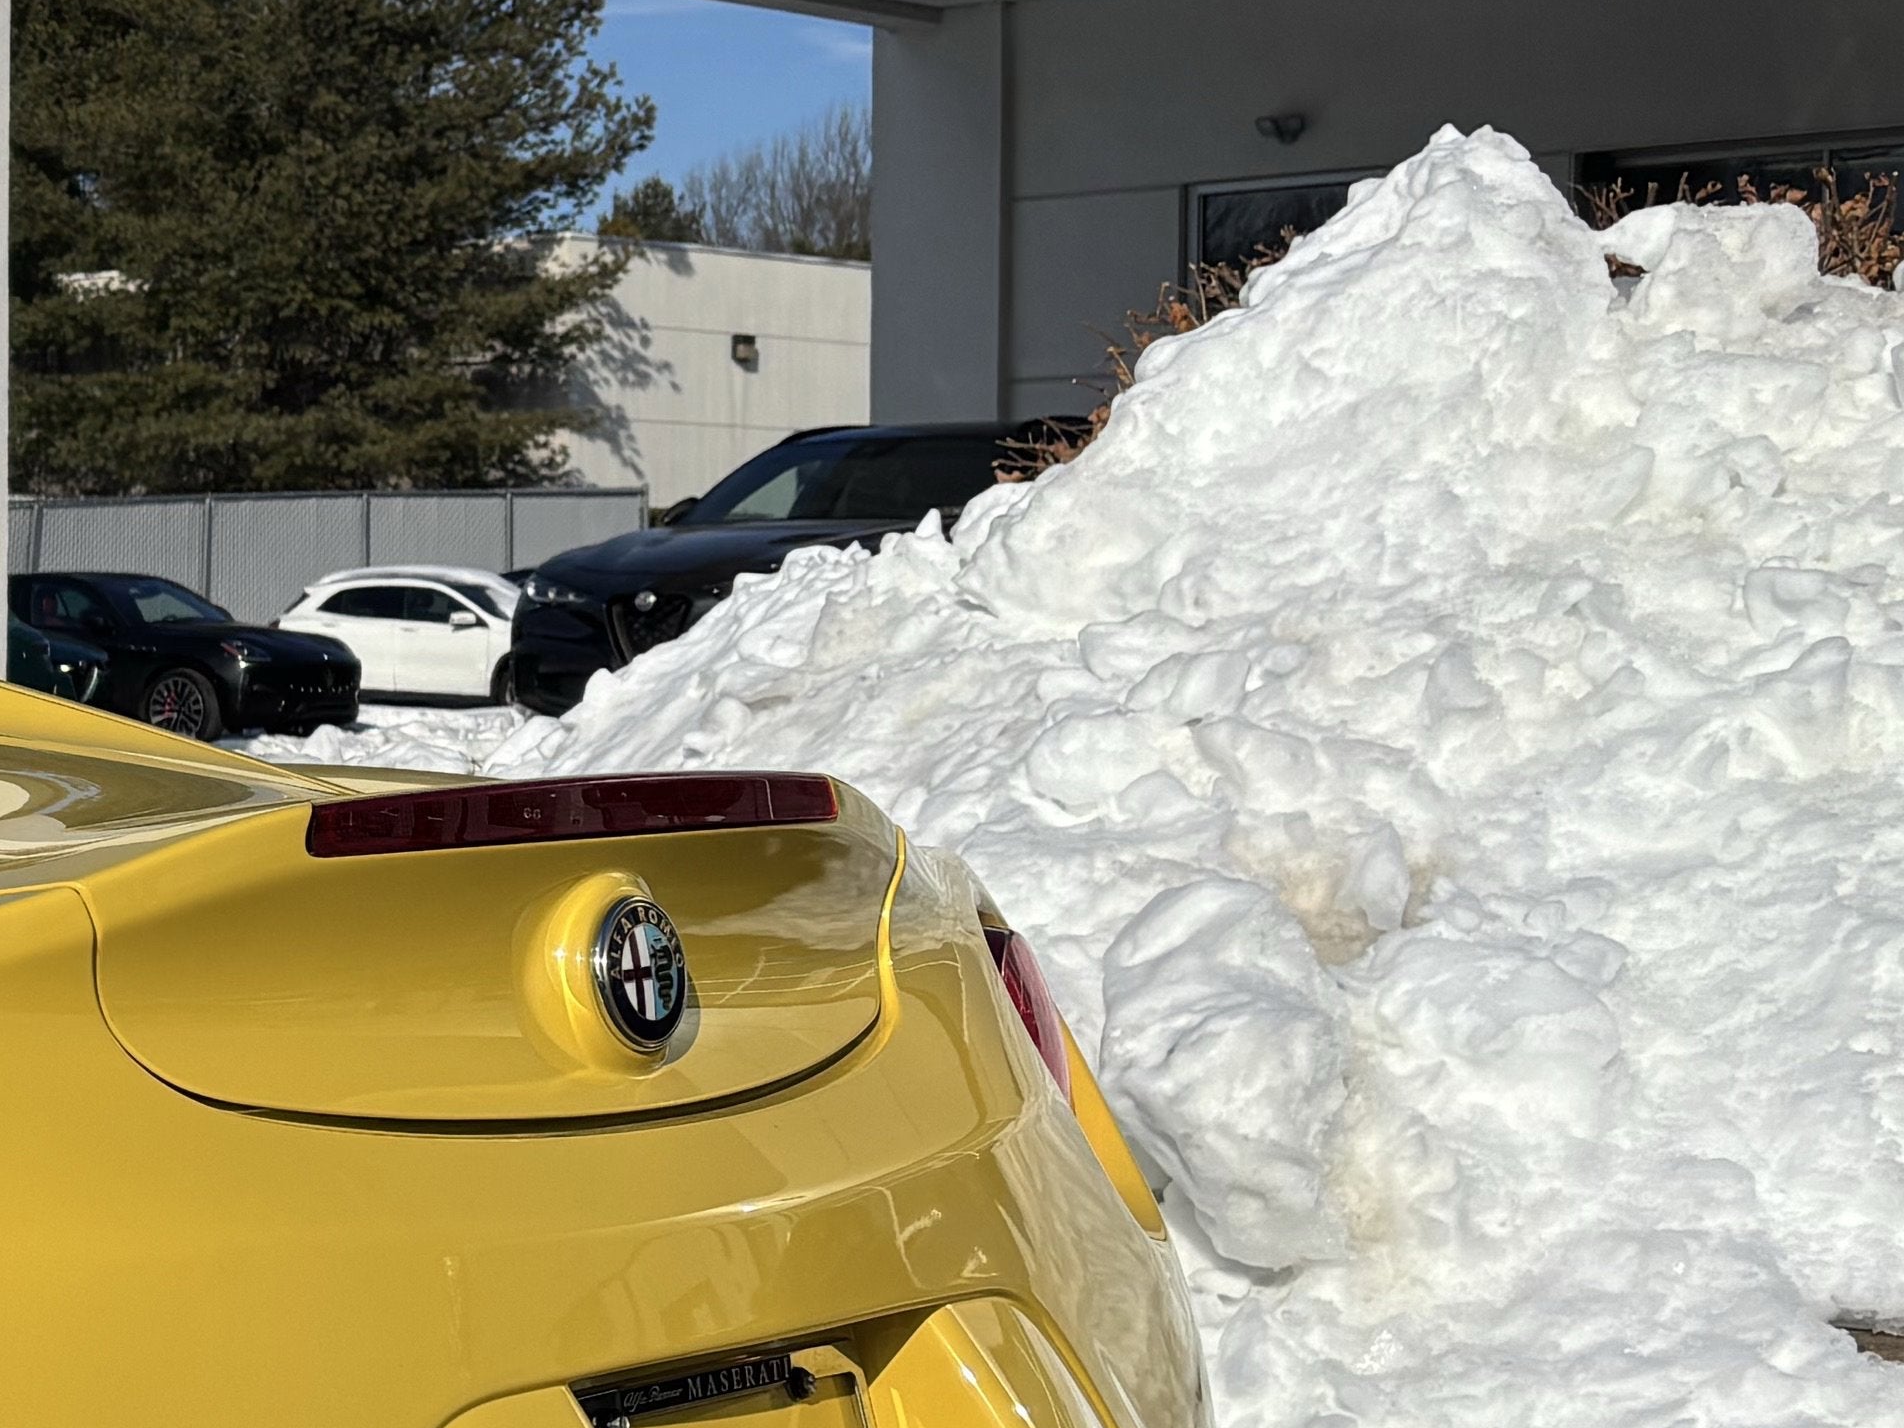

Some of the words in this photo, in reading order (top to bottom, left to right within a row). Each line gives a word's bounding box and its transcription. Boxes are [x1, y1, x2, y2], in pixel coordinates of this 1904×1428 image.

[610, 918, 632, 980] ALFA
[637, 906, 685, 968] ROMEO
[687, 1356, 791, 1401] MASERATI
